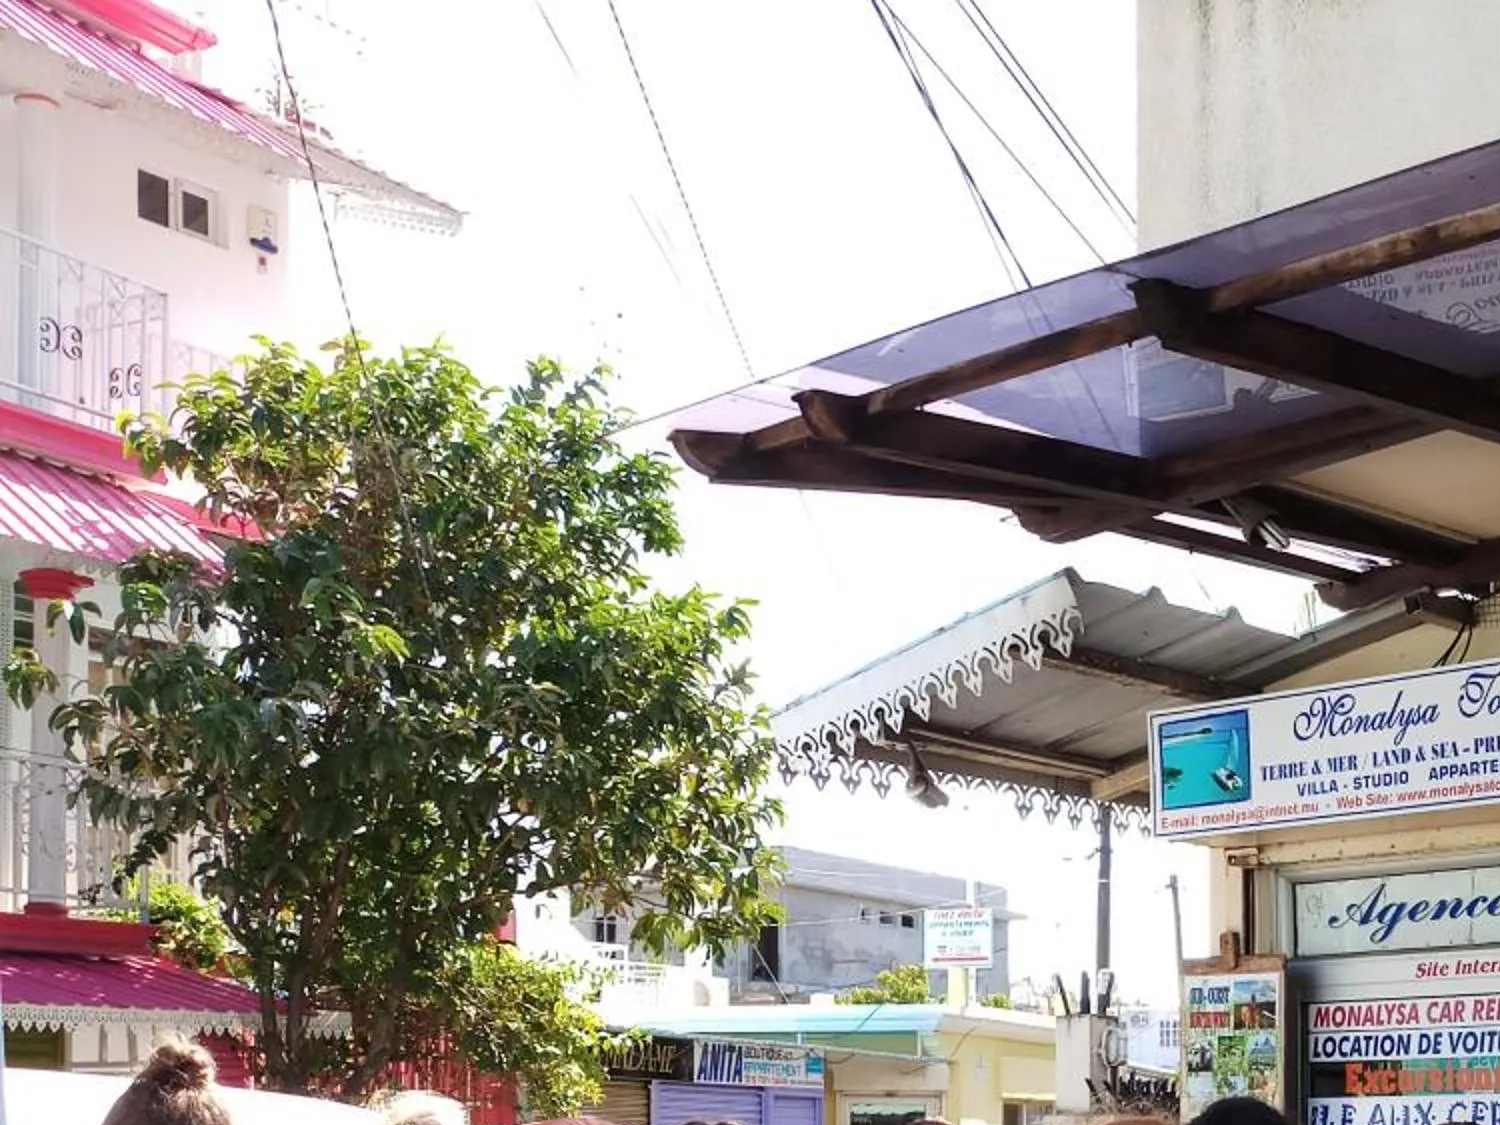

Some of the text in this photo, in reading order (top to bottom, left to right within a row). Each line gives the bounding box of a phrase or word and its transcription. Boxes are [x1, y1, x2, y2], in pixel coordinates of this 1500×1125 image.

[1292, 688, 1441, 746] Monalysa
[1260, 761, 1307, 783] TERRE
[1311, 759, 1324, 777] &
[1326, 755, 1358, 775] MER
[1372, 748, 1411, 769] LAND
[1414, 744, 1426, 762] &
[1430, 738, 1461, 760] SEA
[1296, 780, 1339, 797] VILLA
[1353, 770, 1409, 791] STUDIO
[1161, 812, 1199, 830] E-mail:
[1336, 793, 1363, 810] Web
[1365, 788, 1394, 806] Site:
[1415, 961, 1449, 979] Site
[1314, 1002, 1420, 1029] MONALYSA
[1426, 999, 1466, 1024] CAR
[697, 1042, 743, 1083] ANITA
[1313, 1033, 1413, 1059] LOCATION
[1417, 1031, 1441, 1055] DE
